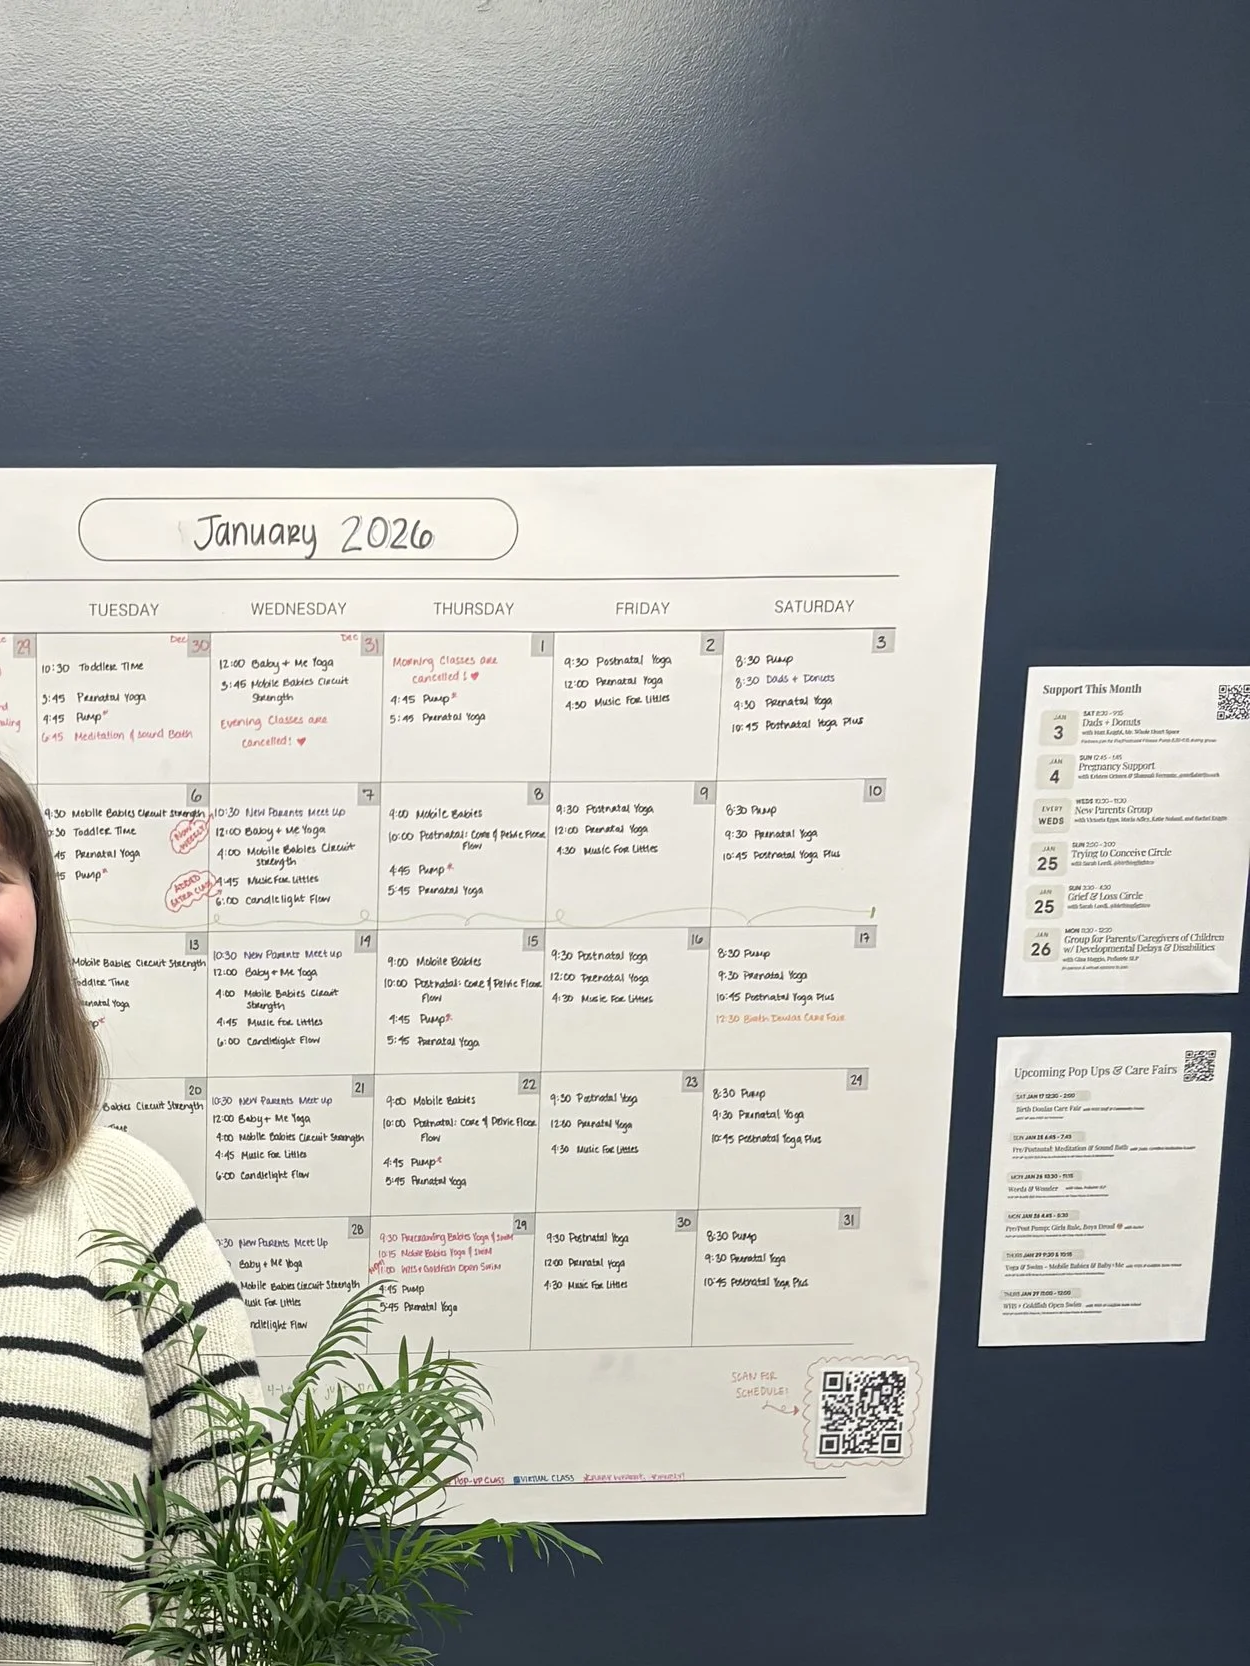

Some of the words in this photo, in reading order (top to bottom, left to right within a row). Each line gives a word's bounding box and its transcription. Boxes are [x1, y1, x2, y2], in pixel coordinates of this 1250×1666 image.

[193, 515, 318, 559] January
[340, 514, 436, 552] 2026
[89, 604, 159, 616] TUESDAY
[251, 602, 346, 615] WEDNESDAY
[434, 602, 514, 615] THURSDAY
[616, 602, 669, 614] FRIDAY
[775, 600, 854, 613] SATURDAY
[365, 637, 379, 653] 31
[705, 639, 715, 651] 2
[876, 636, 886, 649] 3
[42, 664, 70, 673] 10:30
[79, 662, 117, 671] Toddler
[220, 659, 245, 669] 12:00
[252, 659, 280, 674] Baby
[295, 659, 307, 667] Me
[313, 657, 333, 671] Yoga
[564, 658, 589, 668] 9:30
[597, 655, 643, 667] Postnatal
[652, 654, 672, 668] Yoga
[736, 655, 760, 668] 8:30
[766, 655, 793, 665] Pump
[1043, 684, 1082, 696] Support
[1085, 684, 1107, 694] This
[1110, 684, 1142, 694] Month
[566, 701, 586, 710] 4:30
[595, 697, 621, 707] Music
[221, 718, 262, 731] Evening
[268, 715, 303, 725] Classes
[1082, 718, 1103, 727] Dads
[1111, 718, 1141, 726] Donuts
[1054, 726, 1064, 739] 3
[1079, 762, 1120, 771] Pregnancy
[1122, 761, 1155, 771] Support
[1050, 770, 1059, 784] 4
[363, 789, 374, 800] 7
[868, 785, 882, 797] 10
[215, 807, 240, 817] 10:30
[246, 808, 265, 817] New
[269, 807, 303, 817] Parents
[308, 808, 329, 817] Meet
[332, 808, 345, 817] Up
[1075, 805, 1092, 814] New
[1095, 805, 1124, 814] Parents
[1127, 805, 1153, 815] Group
[1038, 817, 1064, 825] WEDS
[1071, 849, 1098, 859] Trying
[1111, 849, 1145, 857] Conceive
[1037, 857, 1057, 870] 25
[216, 897, 239, 906] 6:00
[246, 894, 305, 908] Candlelight
[310, 894, 330, 904] Flow
[1031, 943, 1051, 956] 26
[1014, 1067, 1065, 1078] Upcoming
[1068, 1066, 1087, 1077] Pop
[1090, 1066, 1110, 1077] Ups
[1113, 1066, 1122, 1075] &
[1125, 1065, 1149, 1075] Care
[1152, 1065, 1177, 1075] Fairs
[843, 1213, 854, 1227] 31
[521, 1474, 549, 1483] VIRTUAL
[552, 1473, 575, 1482] CLASS
